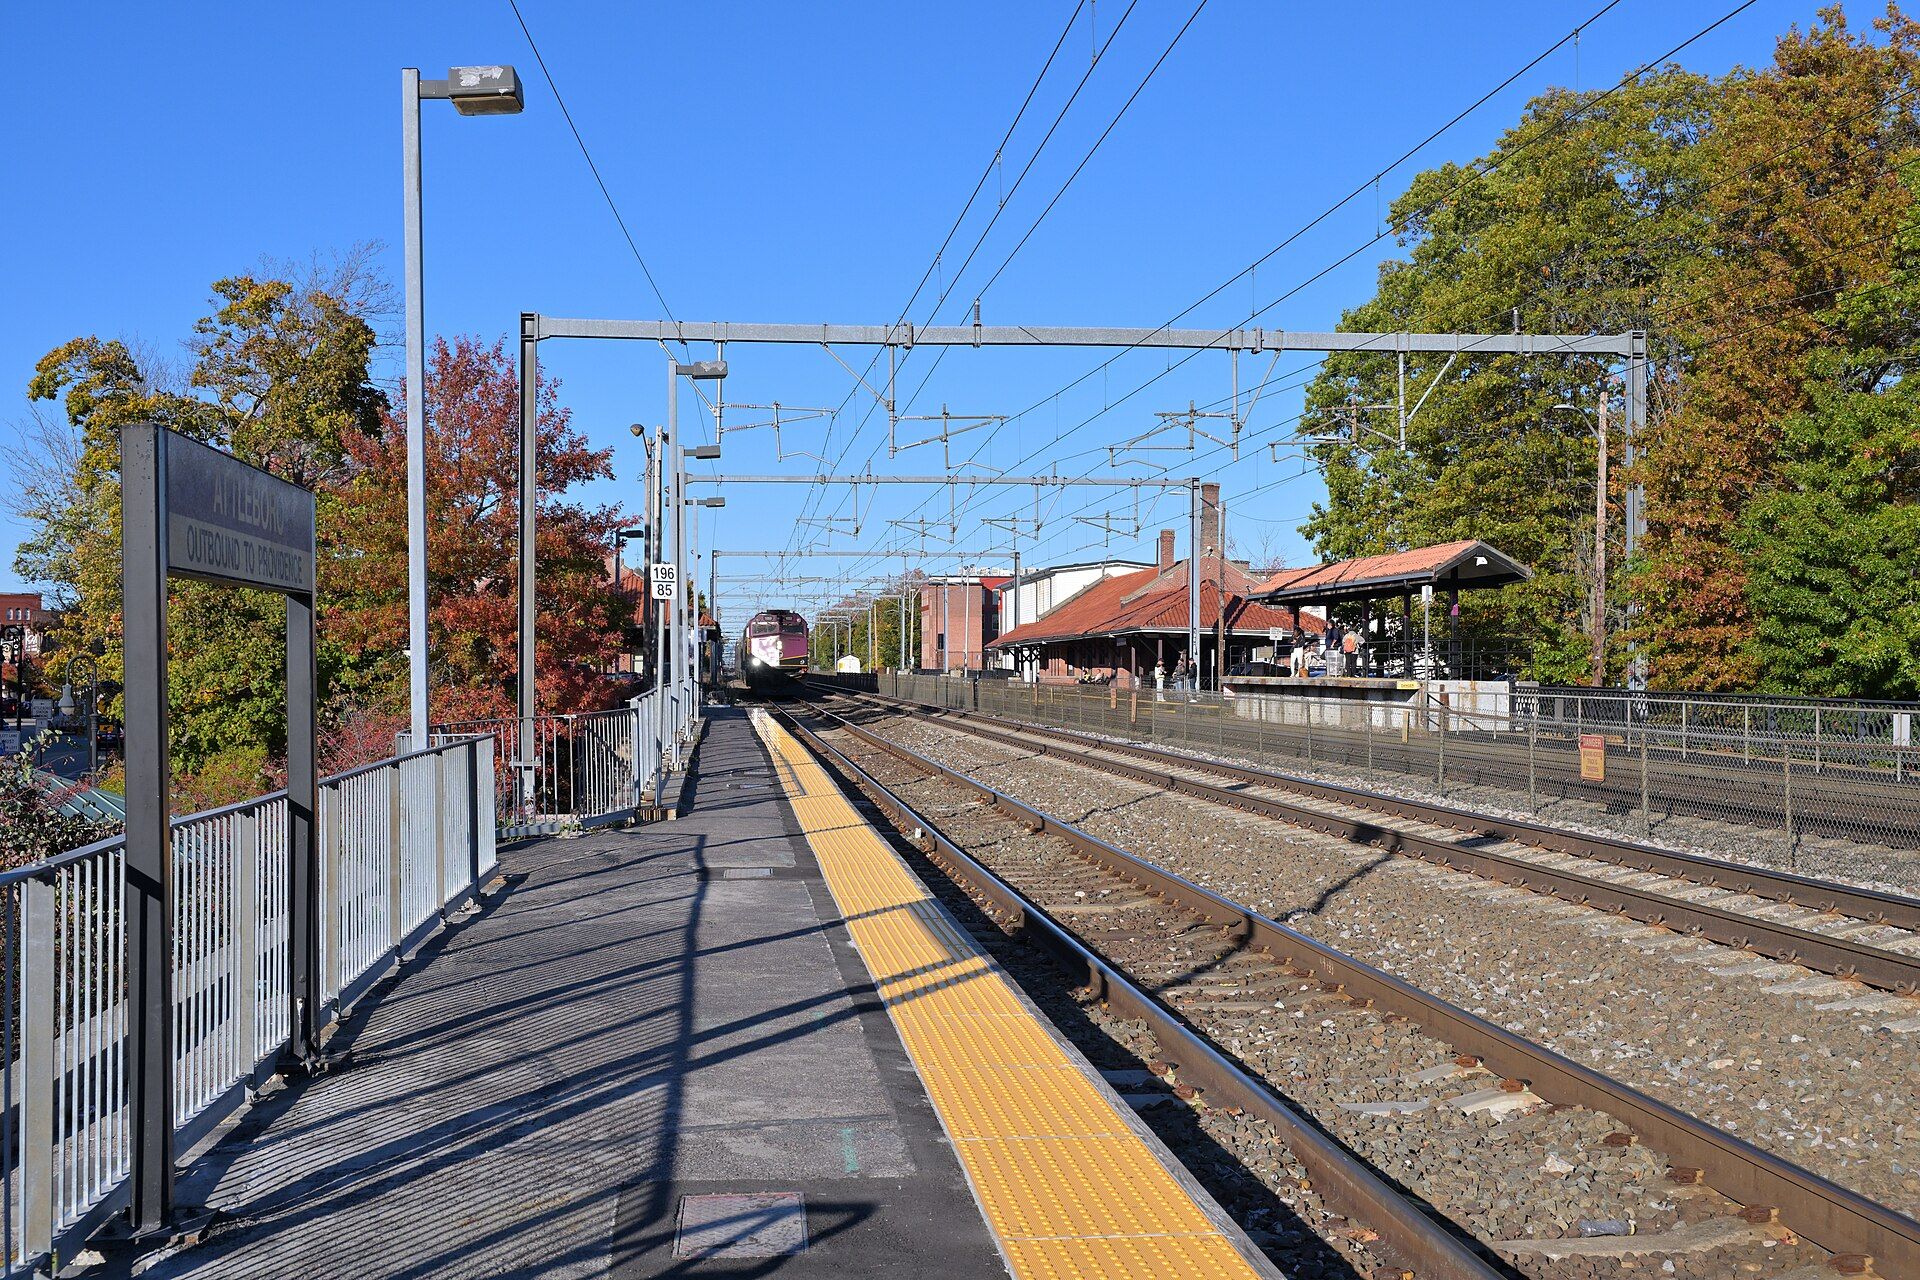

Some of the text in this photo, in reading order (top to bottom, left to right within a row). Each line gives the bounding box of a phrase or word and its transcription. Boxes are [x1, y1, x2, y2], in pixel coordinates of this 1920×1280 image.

[213, 473, 285, 535] ATTLEBORO
[186, 525, 302, 584] OUTBOUND TO PROVIDENCE
[653, 566, 675, 580] 196
[657, 583, 673, 597] 85
